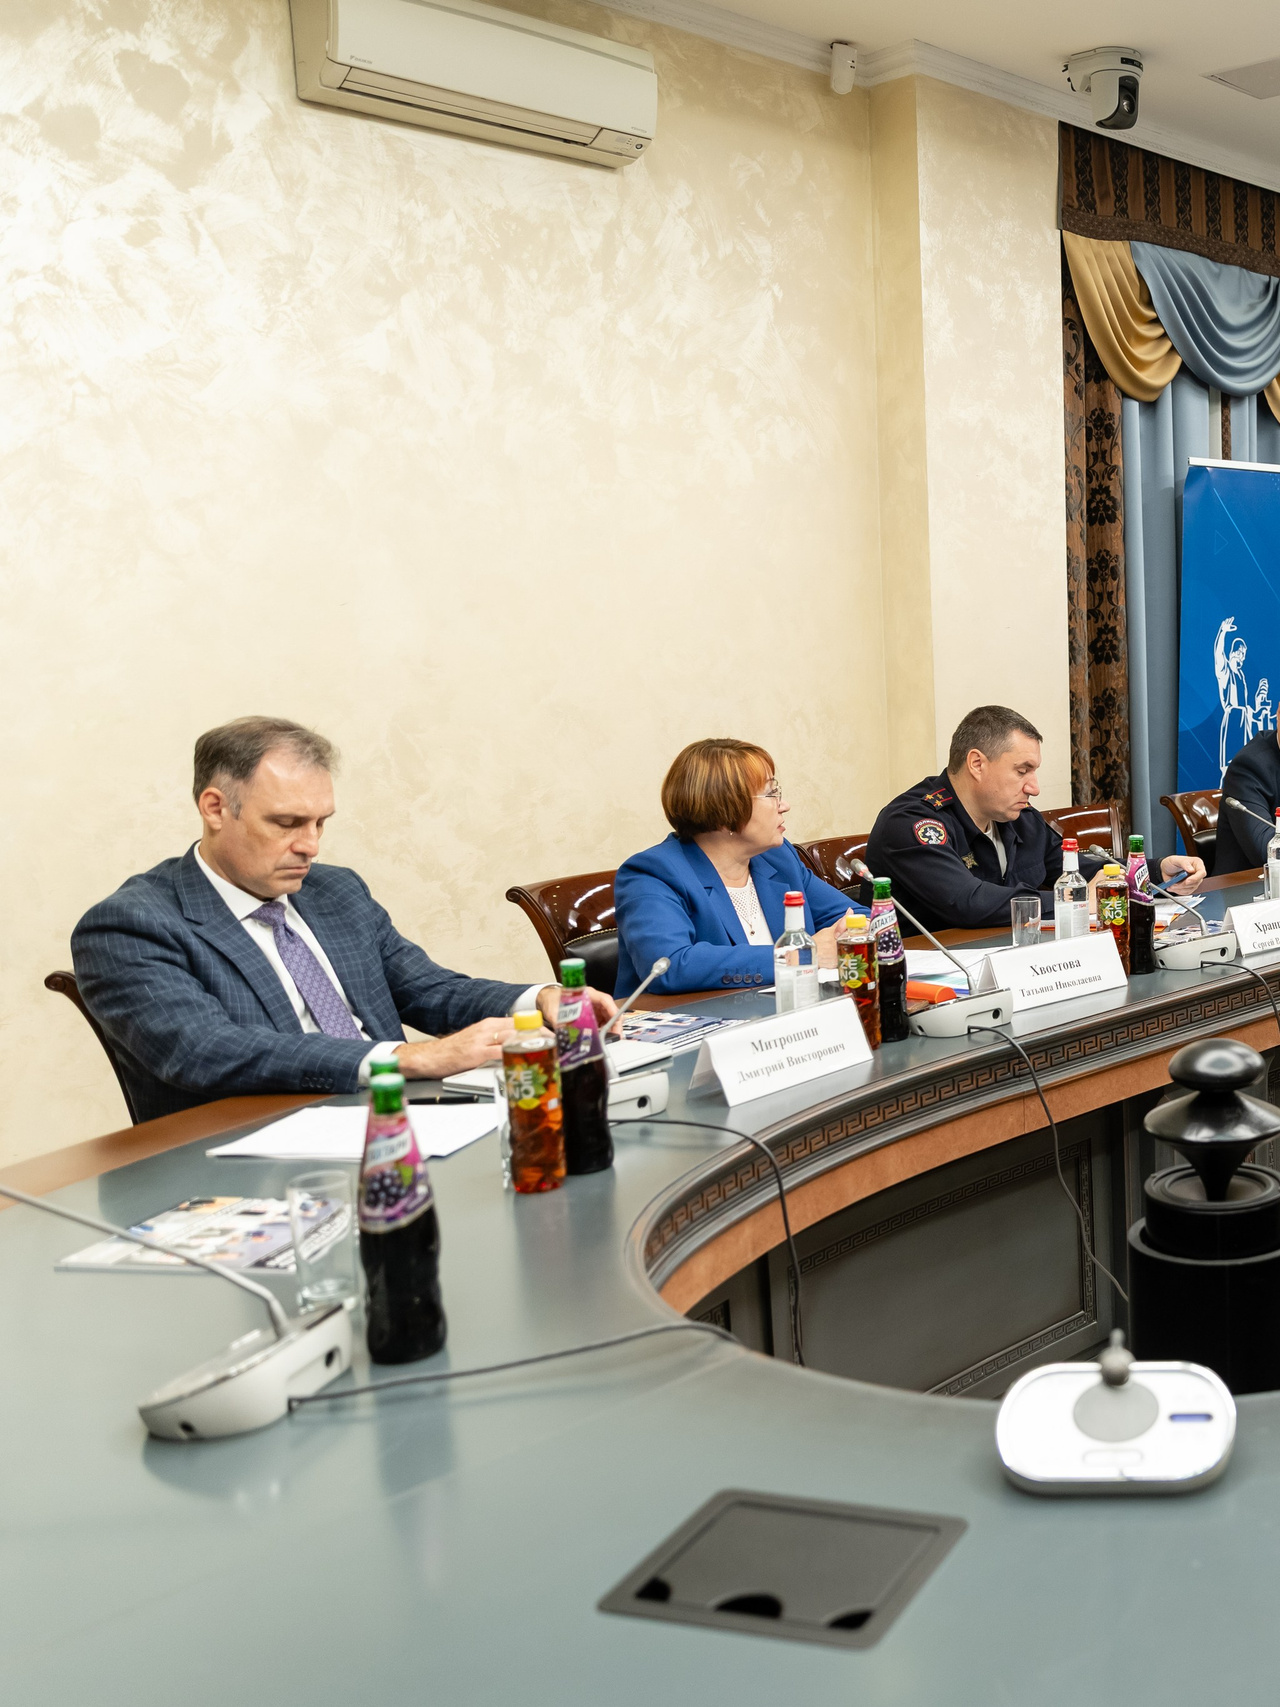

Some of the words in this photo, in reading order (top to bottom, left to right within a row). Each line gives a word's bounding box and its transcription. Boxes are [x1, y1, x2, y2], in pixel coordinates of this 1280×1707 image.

[1104, 901, 1122, 910] ZE
[1104, 910, 1123, 919] NO
[1252, 938, 1275, 950] Сергей
[1029, 959, 1082, 977] Хвостова
[1019, 984, 1054, 998] Татьяна
[1054, 974, 1102, 990] Николаевна
[751, 1027, 819, 1054] Митрошин
[738, 1060, 785, 1084] Дмитрий
[786, 1043, 846, 1068] Викторович
